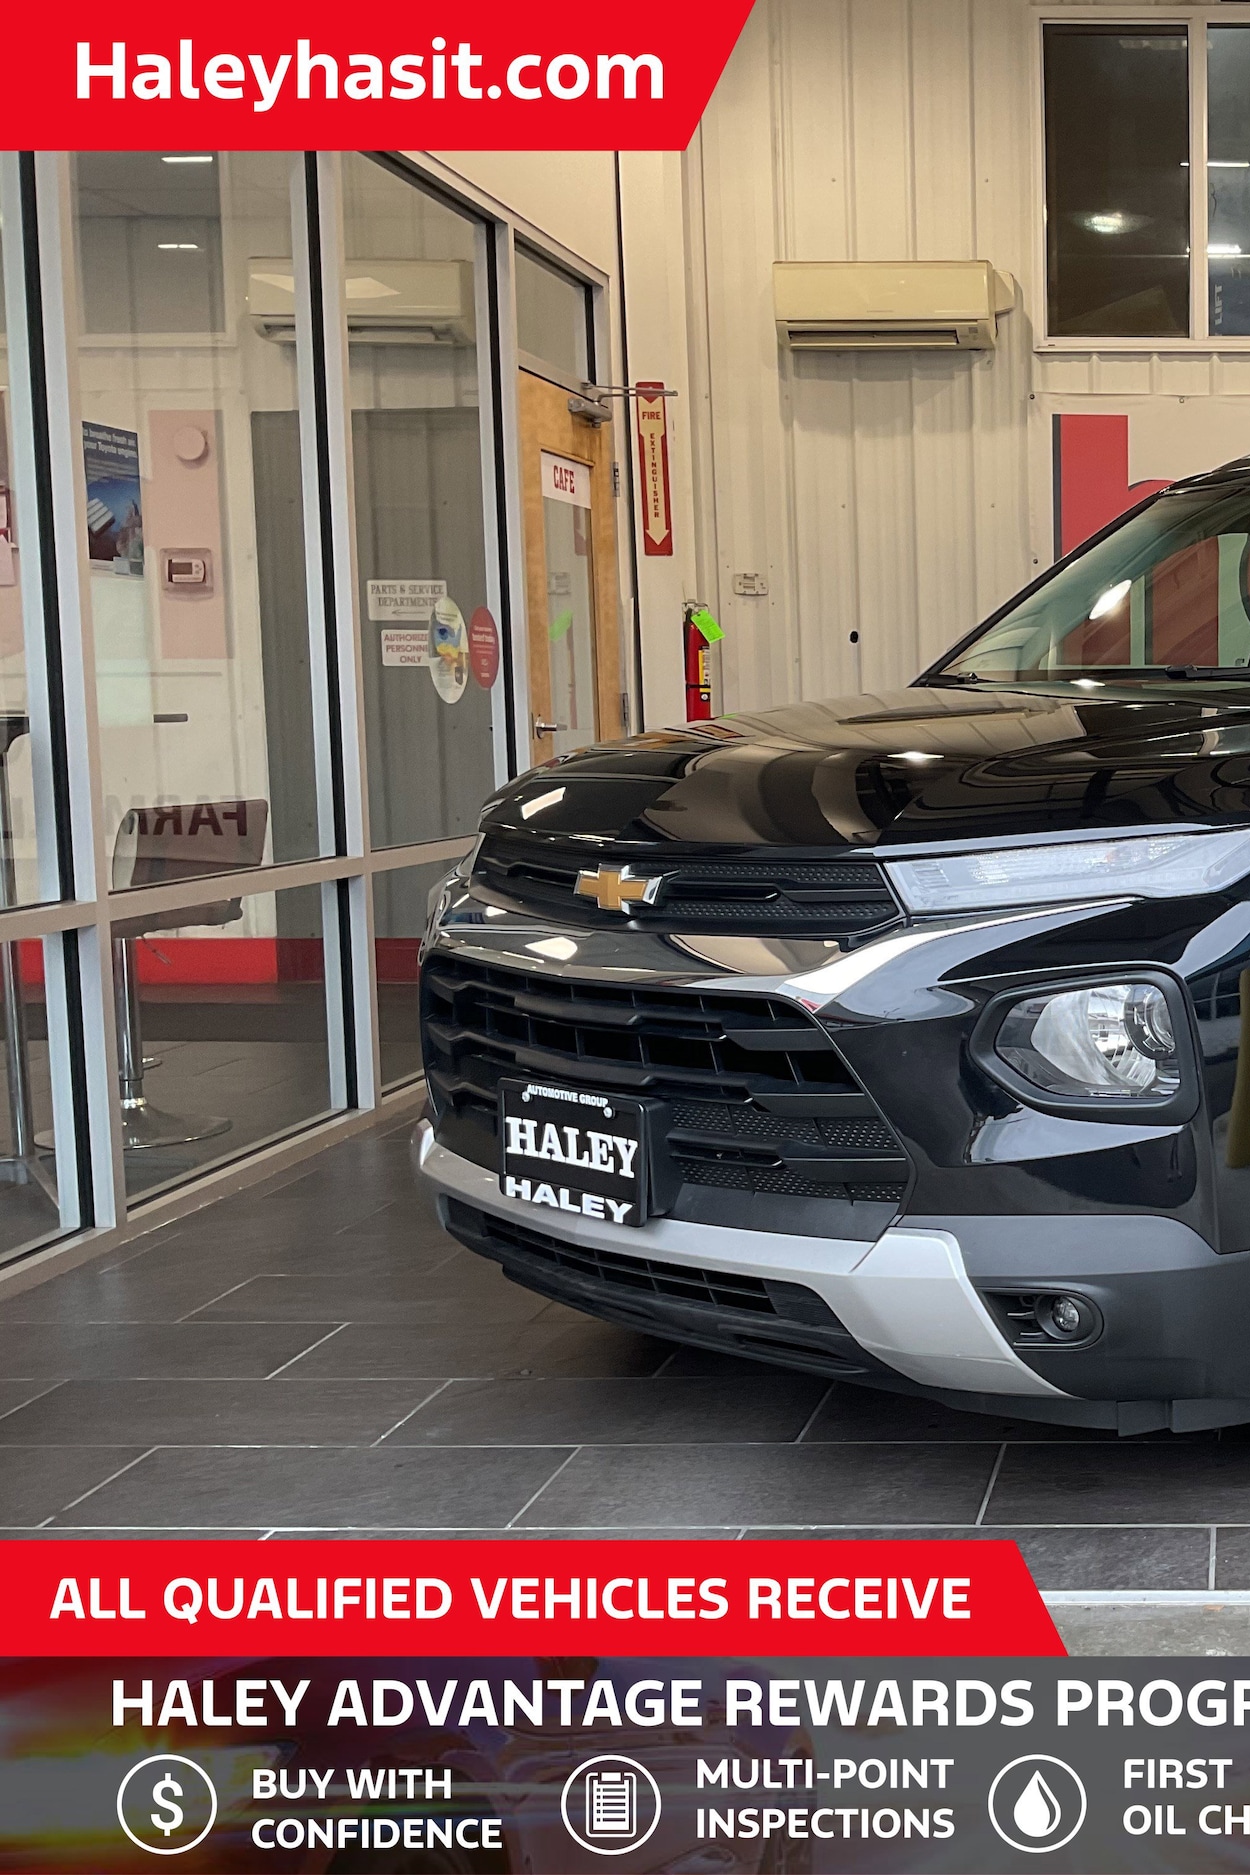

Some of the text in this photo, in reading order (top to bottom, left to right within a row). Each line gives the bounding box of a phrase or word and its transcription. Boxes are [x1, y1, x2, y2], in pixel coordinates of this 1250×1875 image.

[642, 411, 661, 421] FIRE
[553, 464, 575, 494] CAFE
[649, 432, 660, 518] EXTINGUISHER
[370, 584, 397, 595] PARTS
[408, 584, 444, 595] SERVICE
[400, 655, 422, 663] ONLY
[526, 1084, 608, 1108] AUTOMOTIVE GROUP
[505, 1116, 638, 1179] HALEY
[505, 1176, 633, 1224] HALEY
